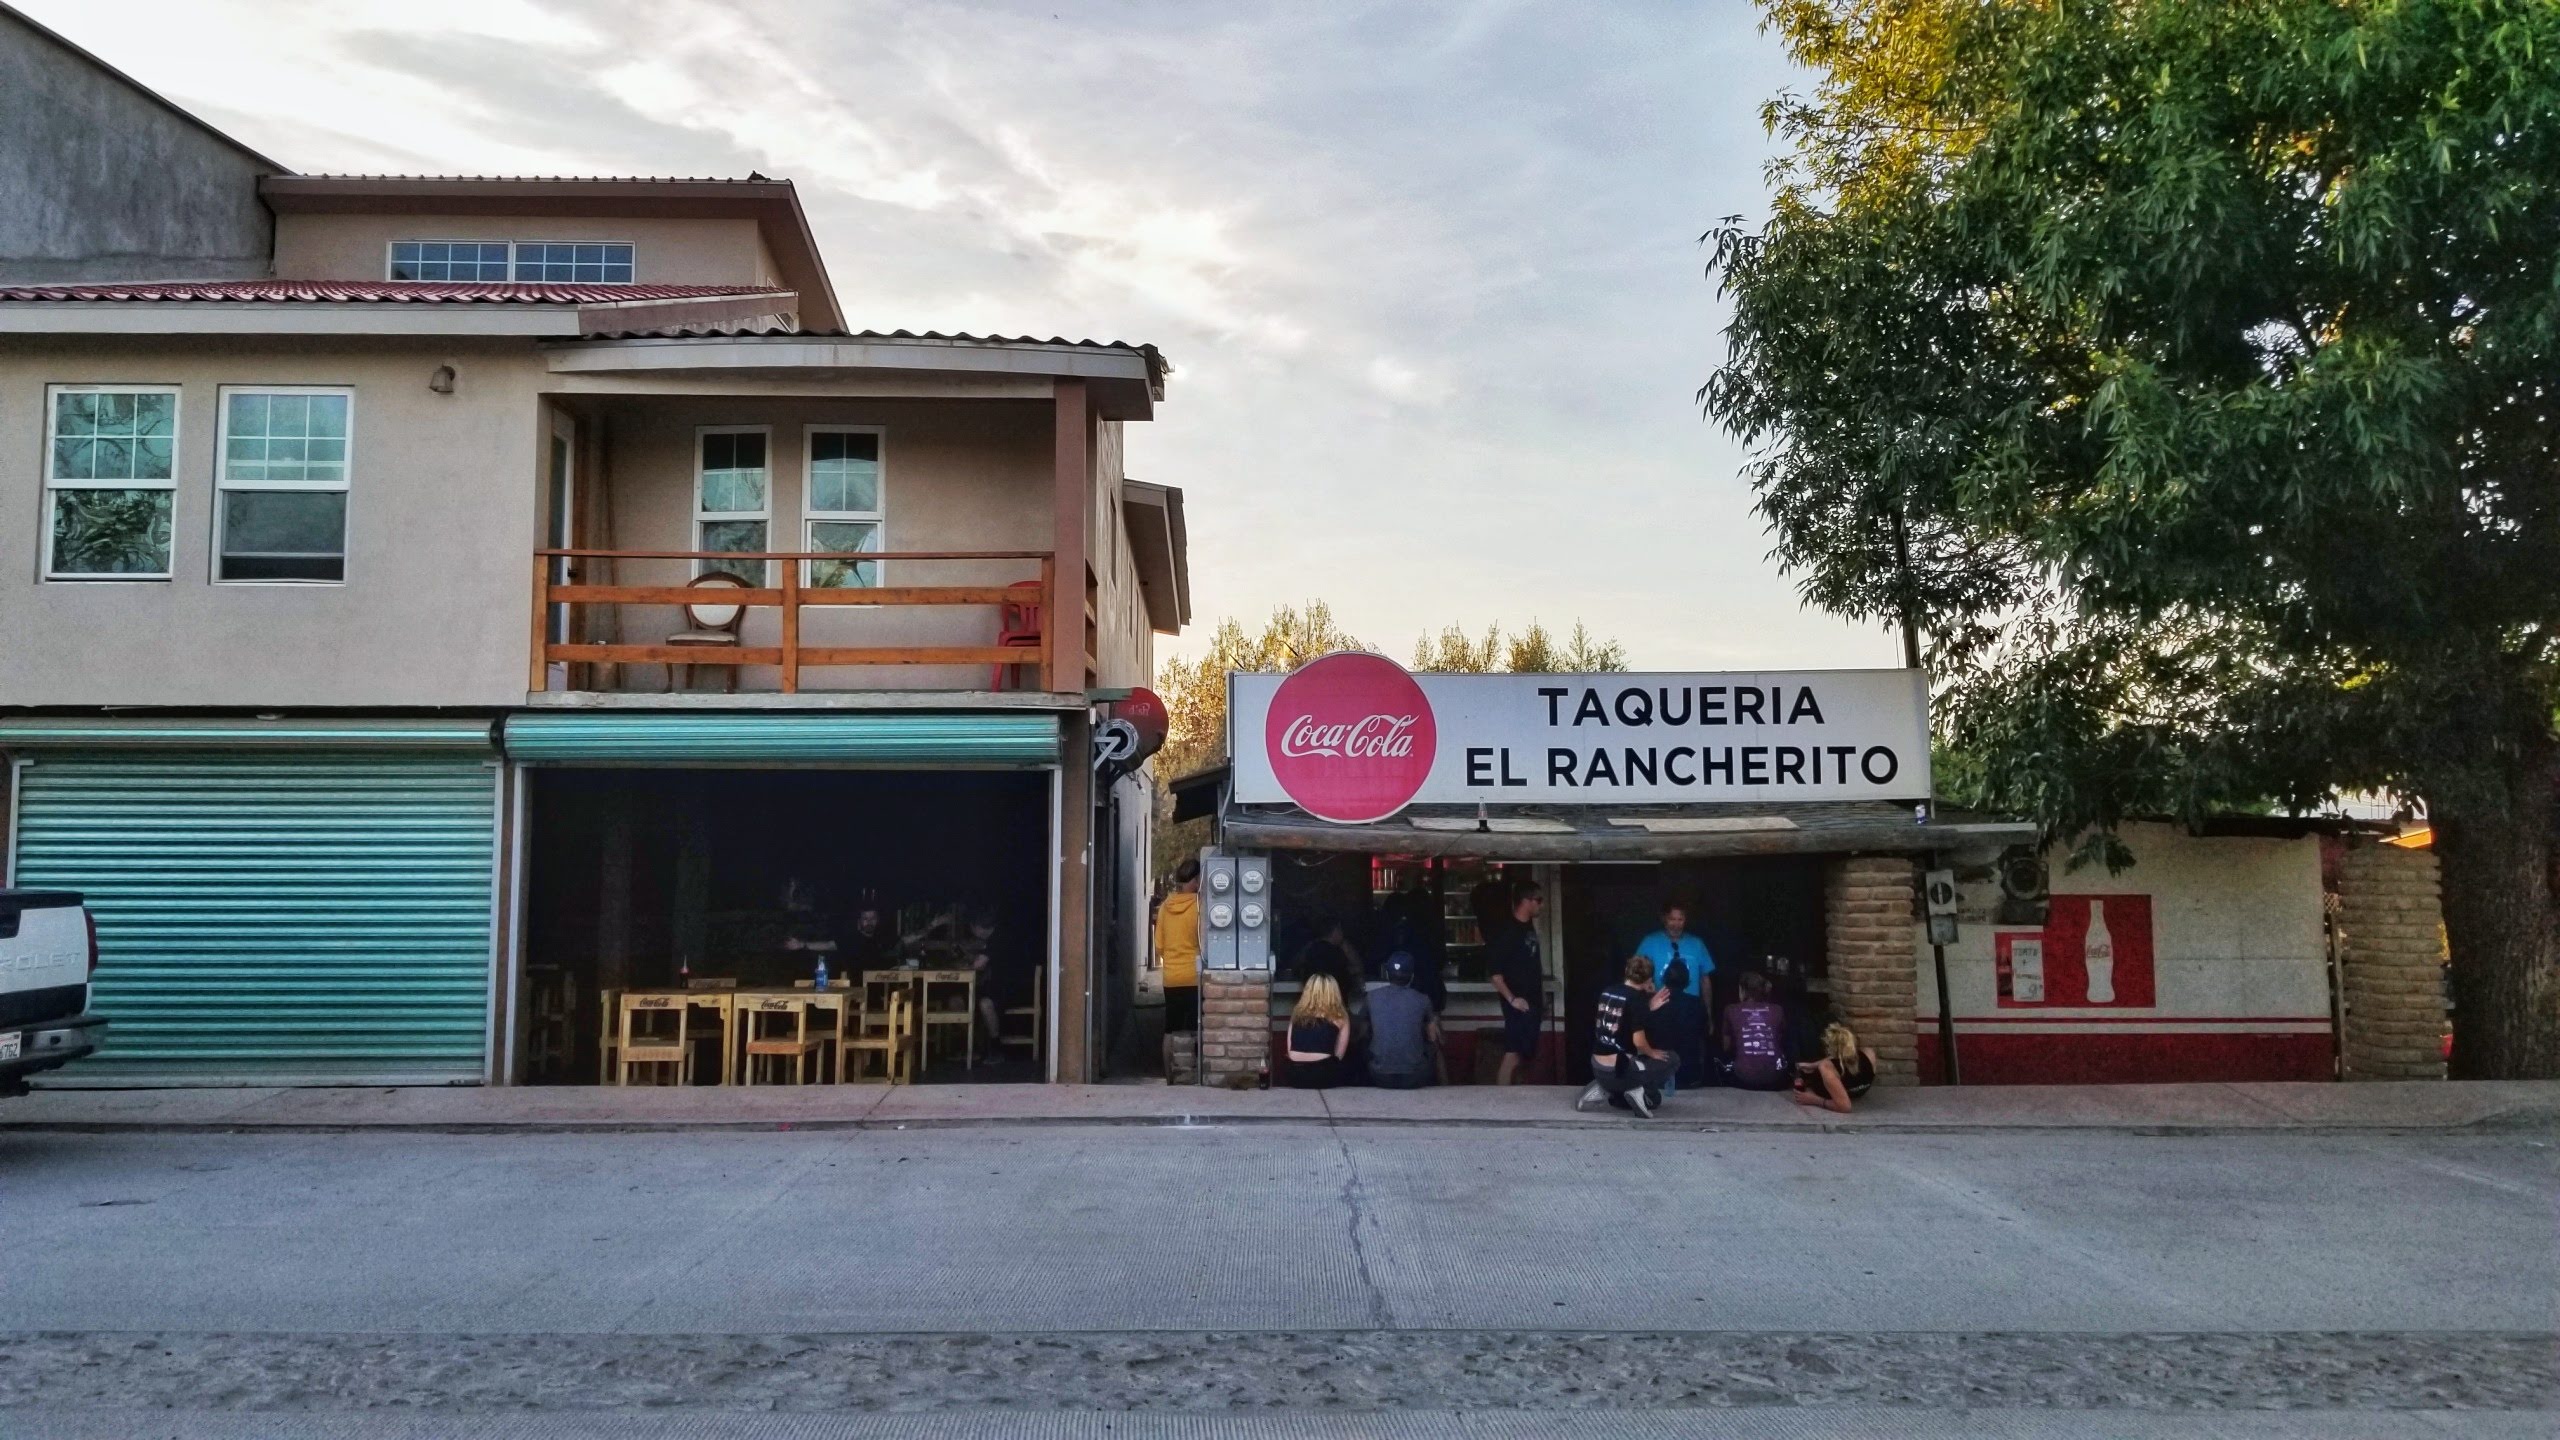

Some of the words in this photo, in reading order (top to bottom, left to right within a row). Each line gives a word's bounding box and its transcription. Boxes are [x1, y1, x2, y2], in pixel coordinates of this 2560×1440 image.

[1128, 702, 1151, 716] dish
[1537, 686, 1825, 727] TAQUERIA
[1281, 714, 1420, 758] Coca-Cola
[1466, 747, 1528, 787] EL
[1547, 745, 1899, 787] RANCHERITO
[639, 997, 670, 1008] Coca-Cola
[761, 1000, 789, 1010] Coca-Cola
